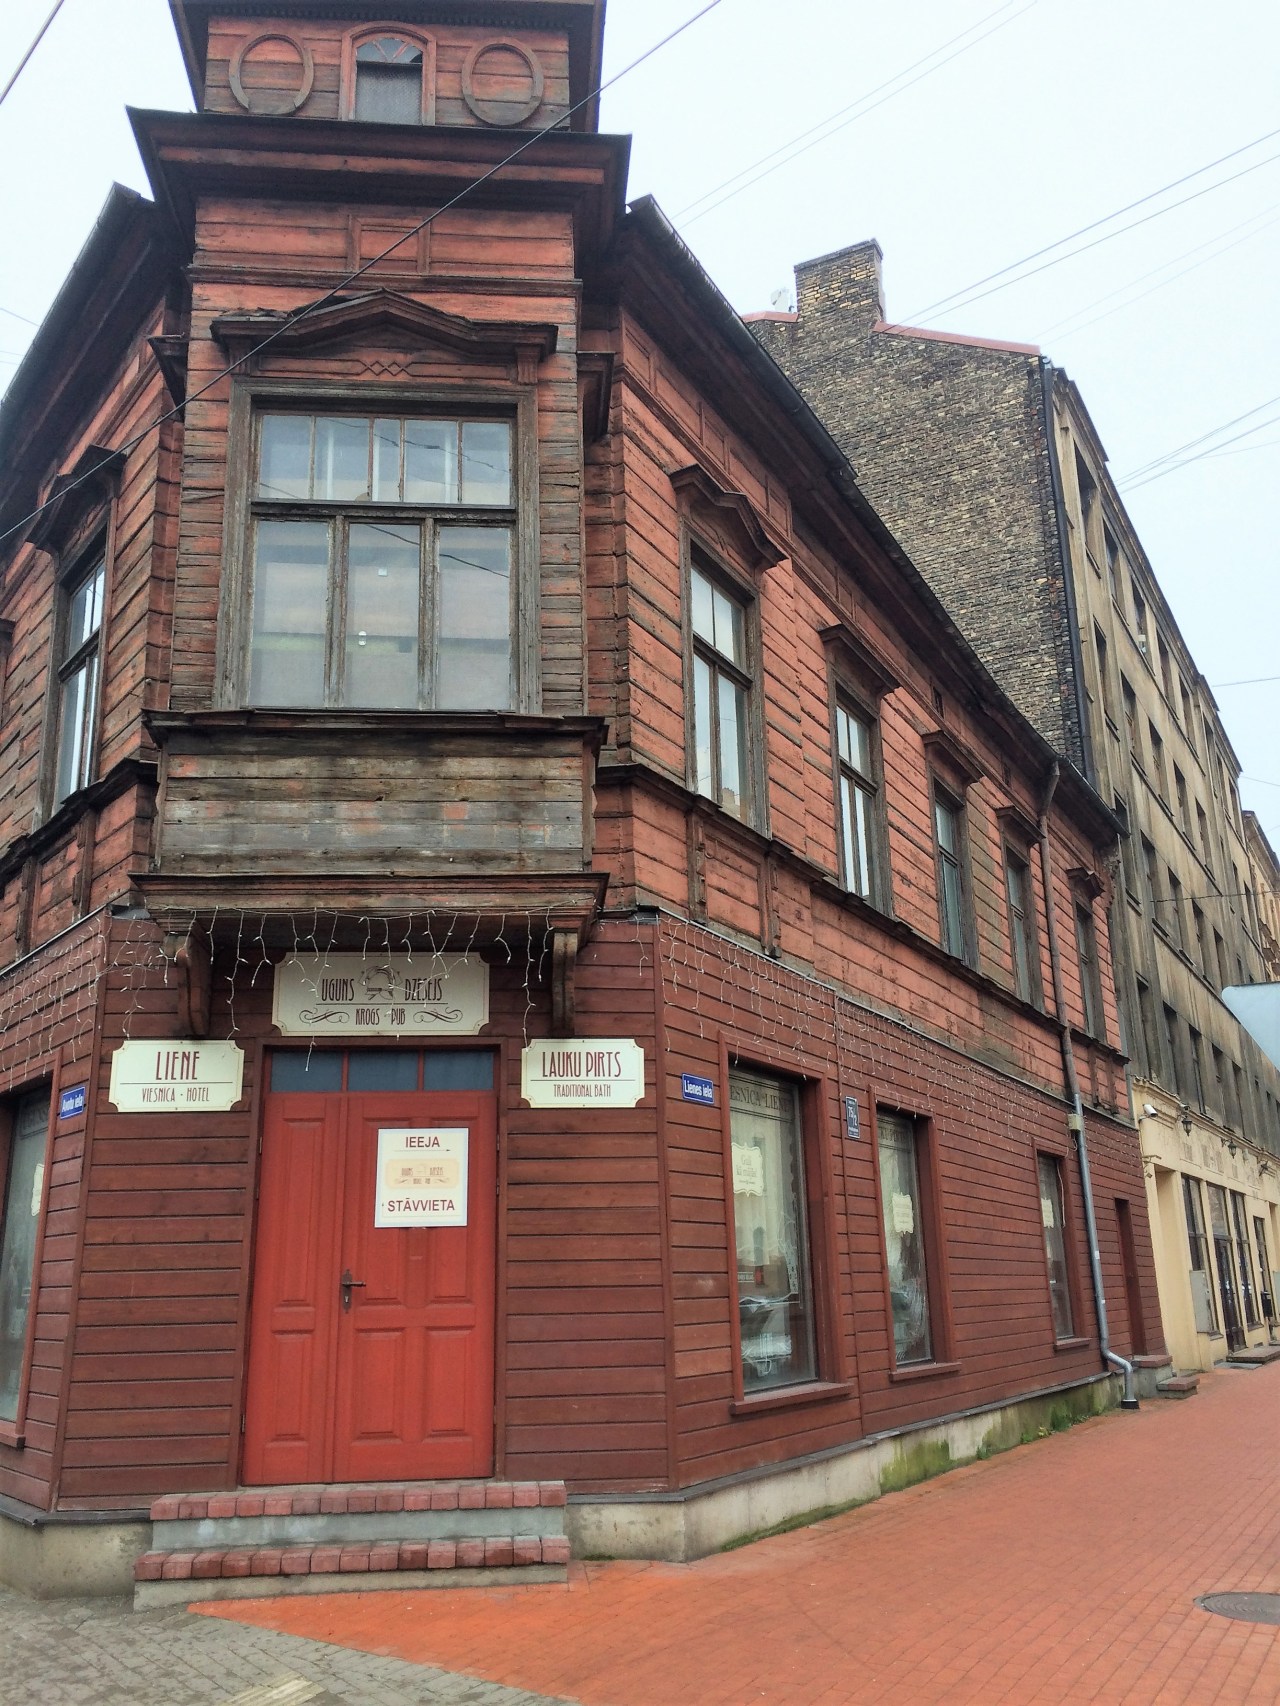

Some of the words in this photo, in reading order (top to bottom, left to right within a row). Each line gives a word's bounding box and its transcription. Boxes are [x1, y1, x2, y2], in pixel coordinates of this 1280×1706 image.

[321, 978, 355, 1002] UGUNS
[355, 1008, 380, 1025] KROGS
[391, 1008, 406, 1025] PUB
[155, 1051, 200, 1080] LIENE
[542, 1051, 582, 1077] LAUKU
[585, 1051, 622, 1077] PIRTS
[186, 1087, 210, 1102] HOTEL
[553, 1084, 593, 1098] TRADITIONAL
[594, 1084, 612, 1097] BATH
[684, 1079, 703, 1096] Lienes
[702, 1084, 713, 1098] iela
[405, 1136, 440, 1148] IEEJA
[387, 1197, 455, 1212] STĀVVIETA
